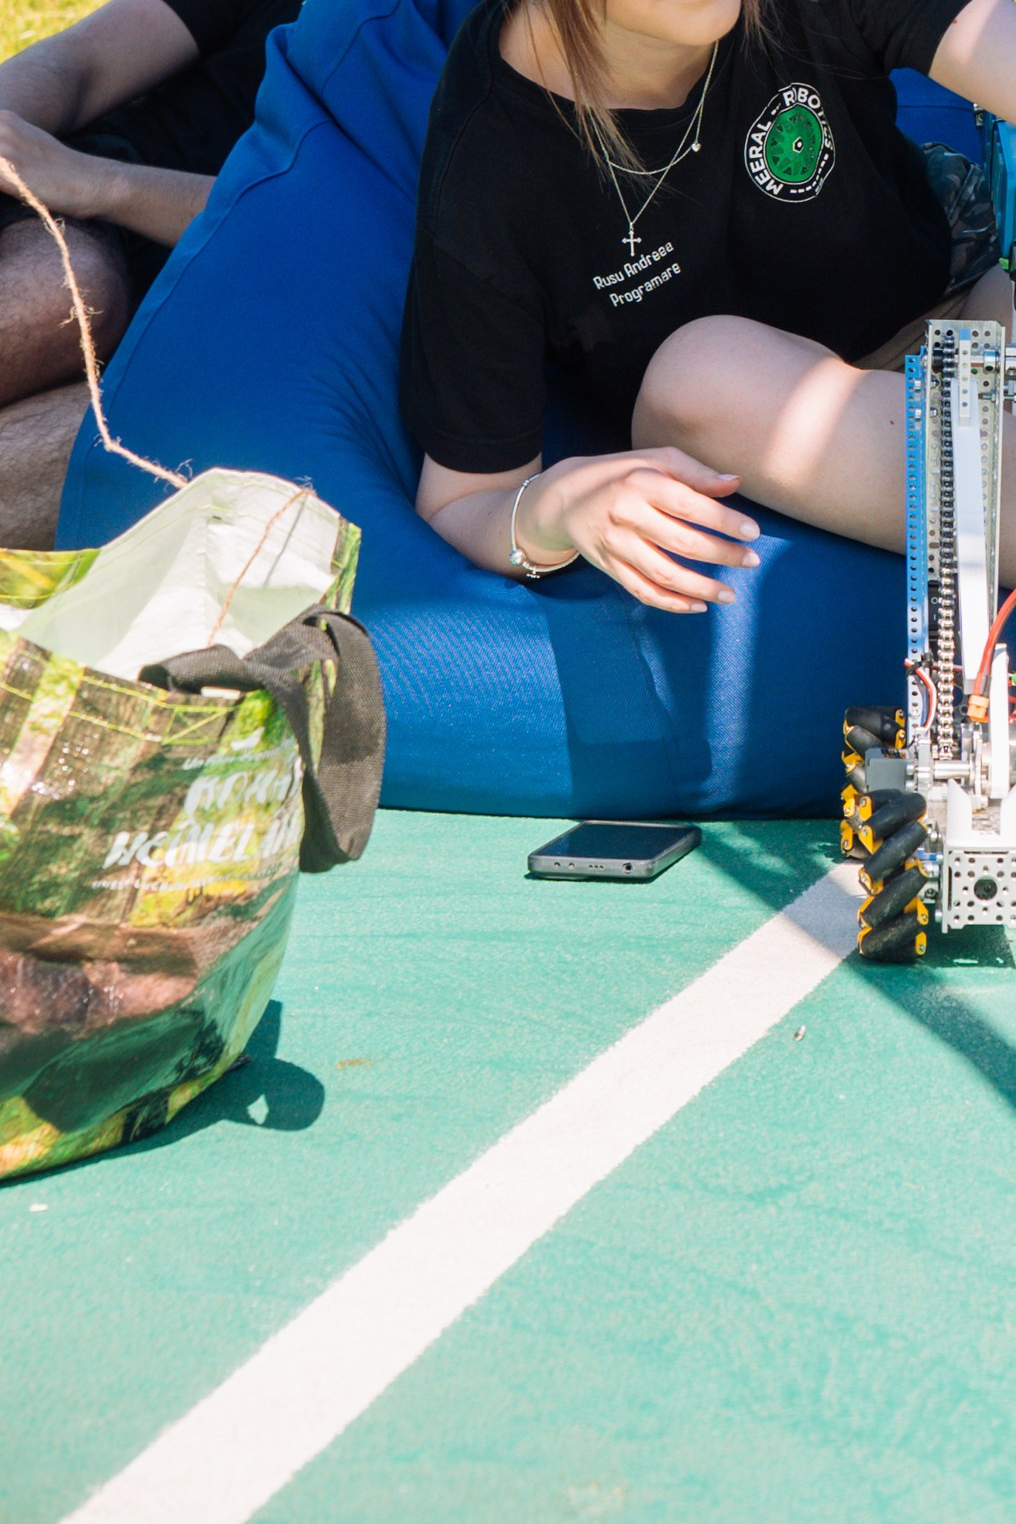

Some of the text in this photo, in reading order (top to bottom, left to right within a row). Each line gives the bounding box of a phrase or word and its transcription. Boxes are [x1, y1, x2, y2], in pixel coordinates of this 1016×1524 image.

[748, 121, 784, 196] MEERAL
[592, 242, 675, 290] Rusu Andreea
[609, 263, 681, 307] Programare
